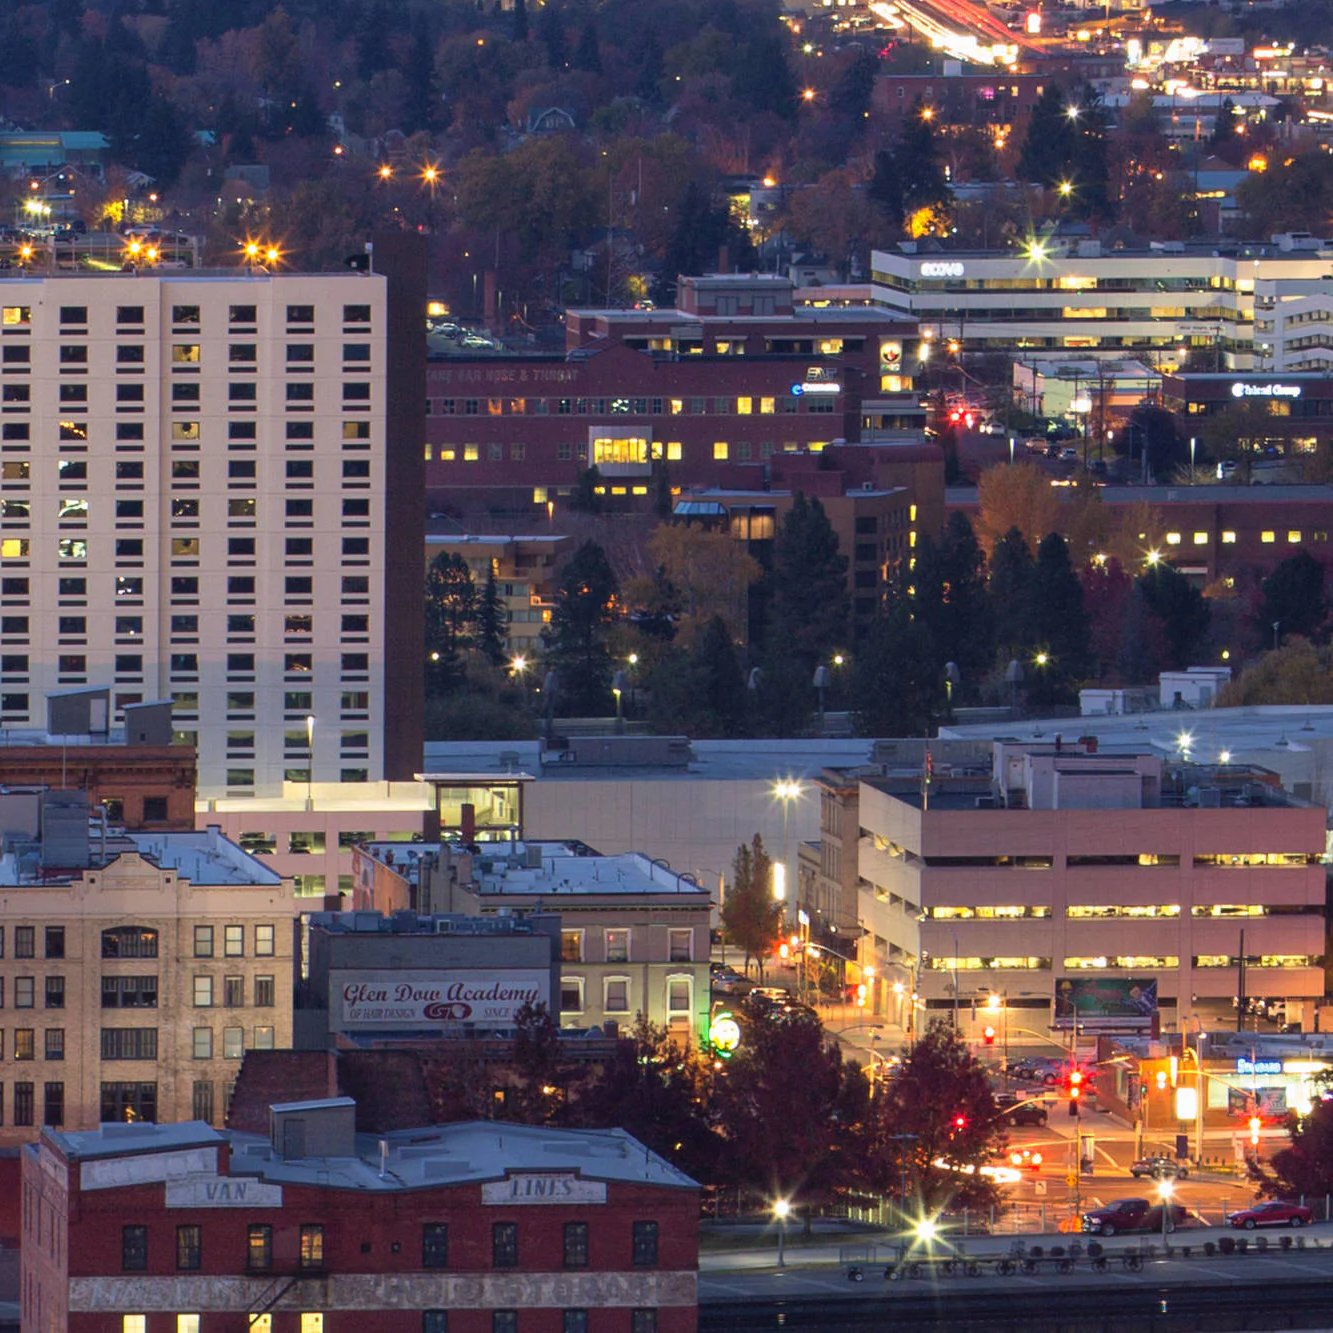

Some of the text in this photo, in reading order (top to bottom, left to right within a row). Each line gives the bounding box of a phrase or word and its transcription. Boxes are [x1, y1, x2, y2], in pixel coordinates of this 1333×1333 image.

[344, 982, 539, 1007] Glen Dow Academy
[206, 1182, 246, 1200] VAN
[511, 1178, 573, 1197] LINES
